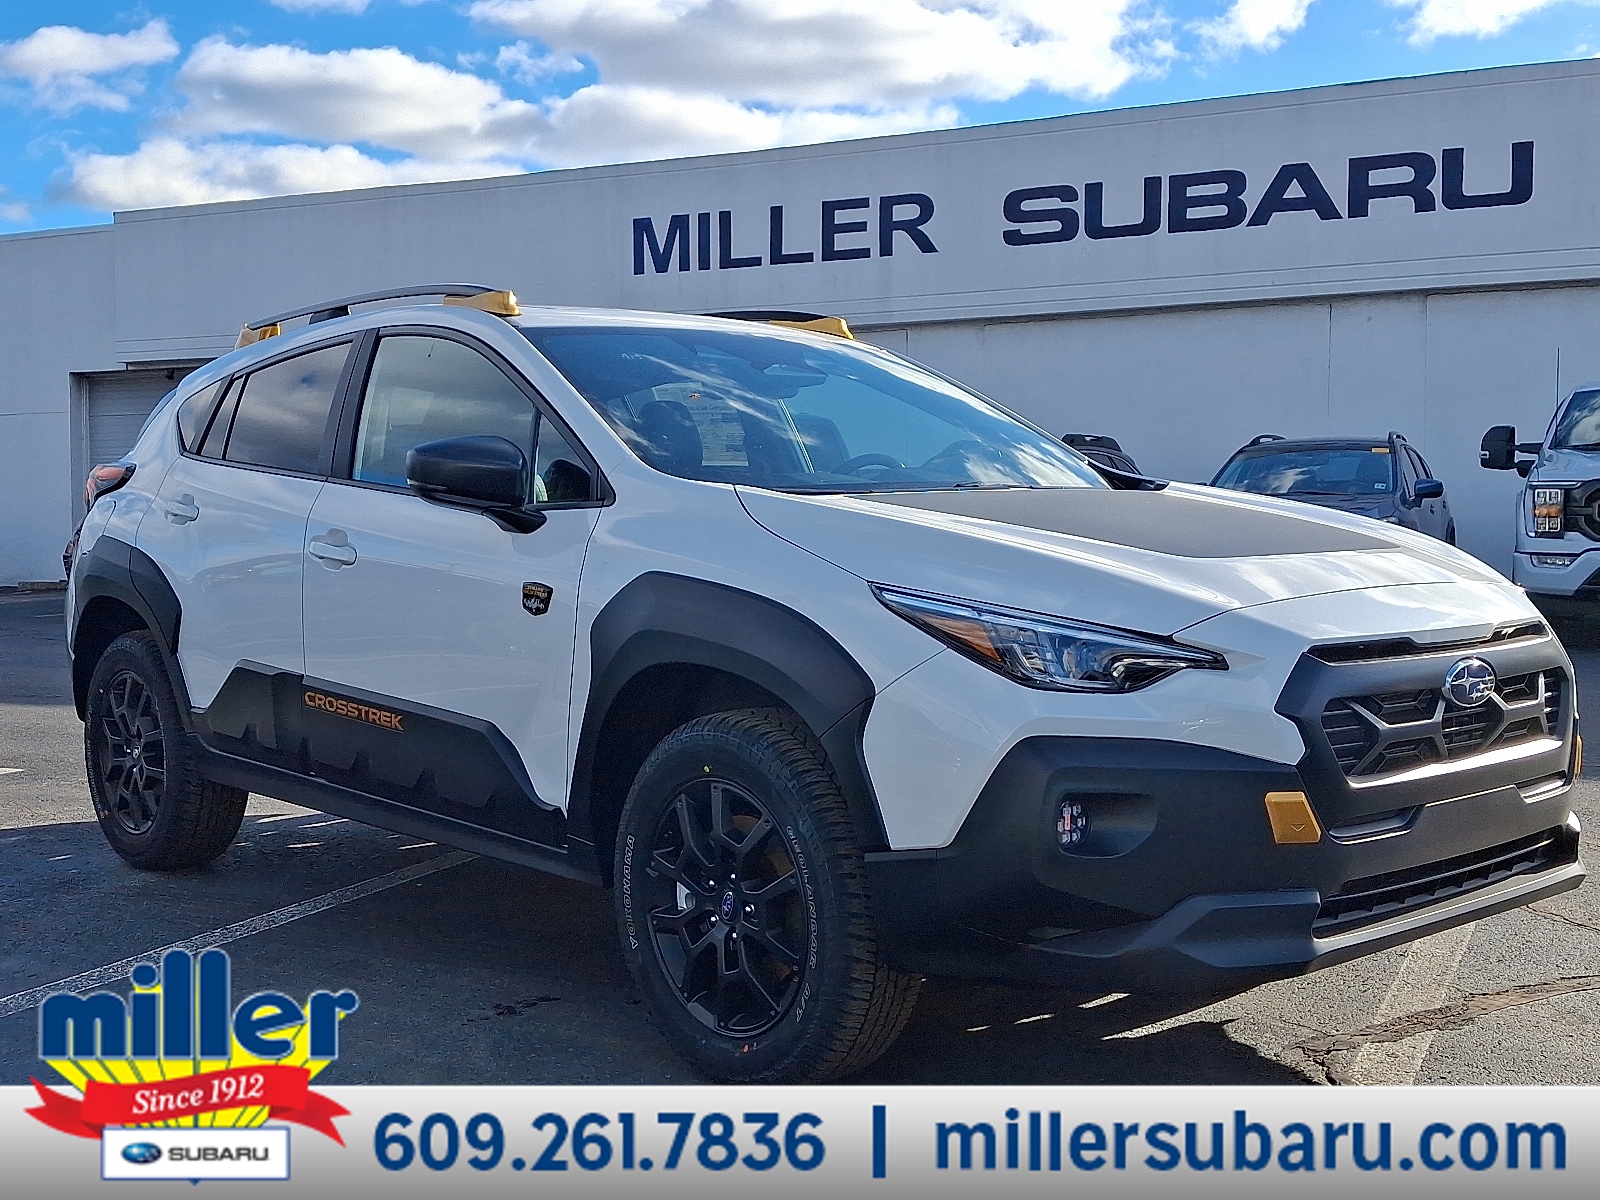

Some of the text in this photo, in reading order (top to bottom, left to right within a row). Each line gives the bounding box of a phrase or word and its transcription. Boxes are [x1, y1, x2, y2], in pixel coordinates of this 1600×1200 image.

[633, 141, 1534, 276] MILLER SUBARU
[304, 691, 404, 731] CROSSTREK
